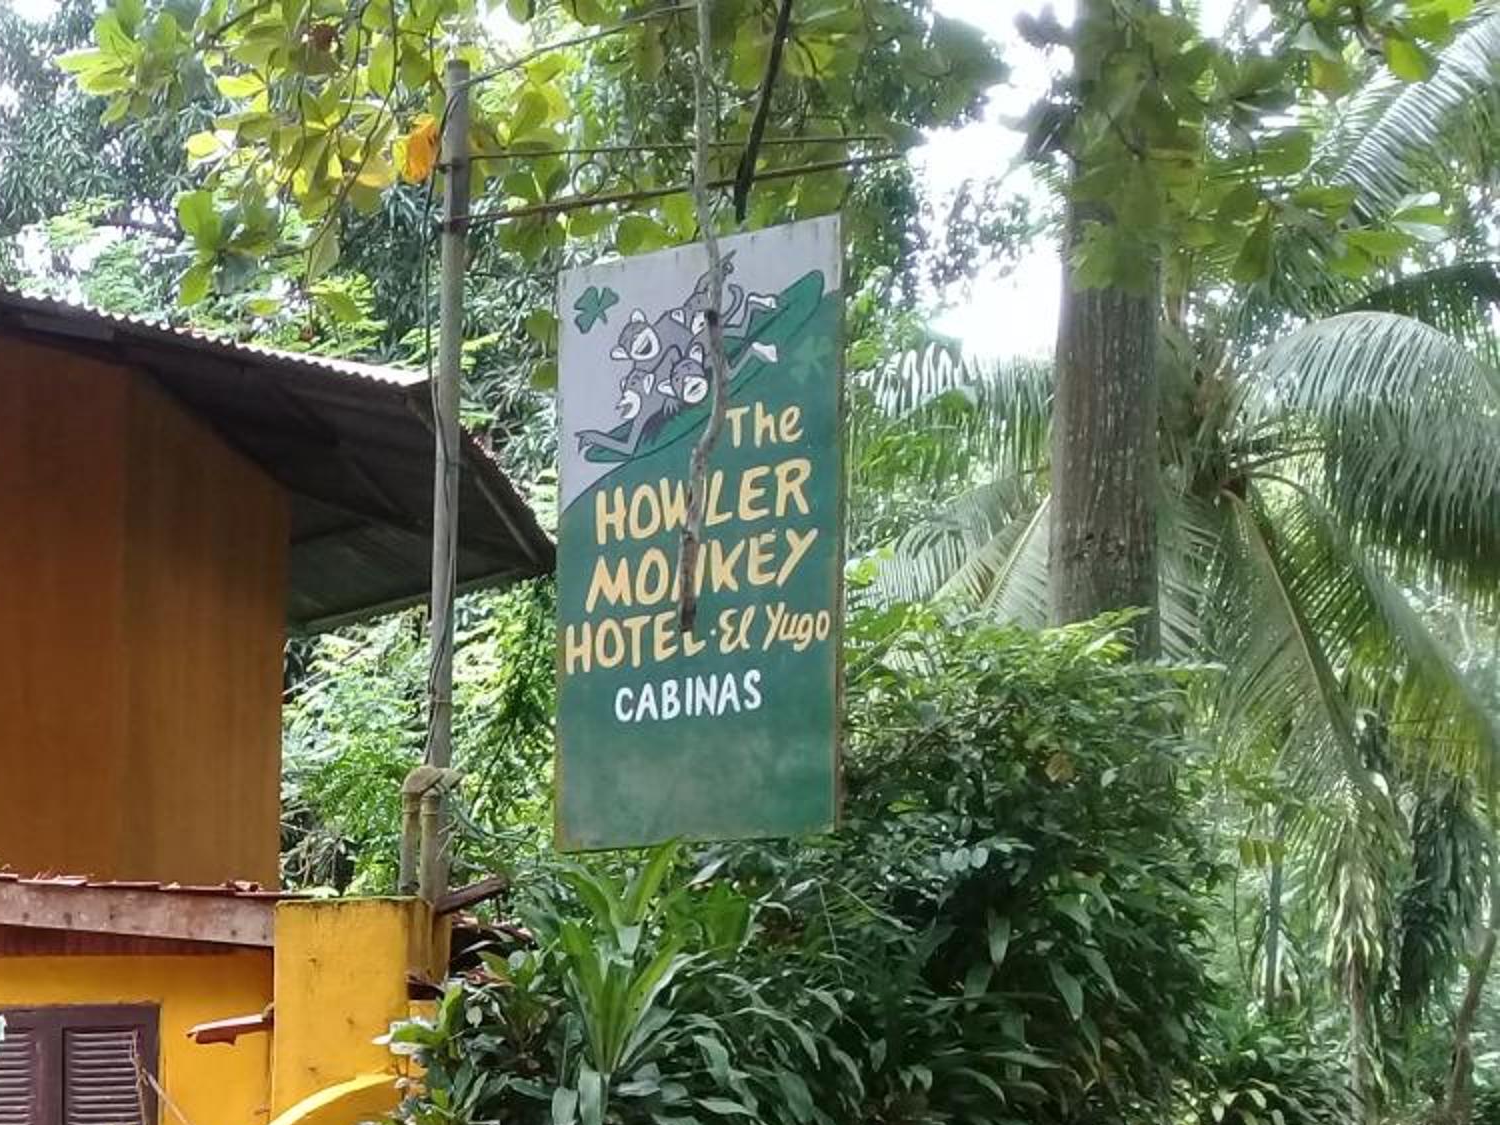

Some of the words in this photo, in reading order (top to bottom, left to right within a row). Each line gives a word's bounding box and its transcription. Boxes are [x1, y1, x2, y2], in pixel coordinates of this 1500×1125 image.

[726, 401, 804, 448] The
[595, 458, 811, 545] HOWLER
[719, 605, 756, 654] El
[762, 601, 830, 652] Yugo
[615, 669, 762, 722] CABINAS
